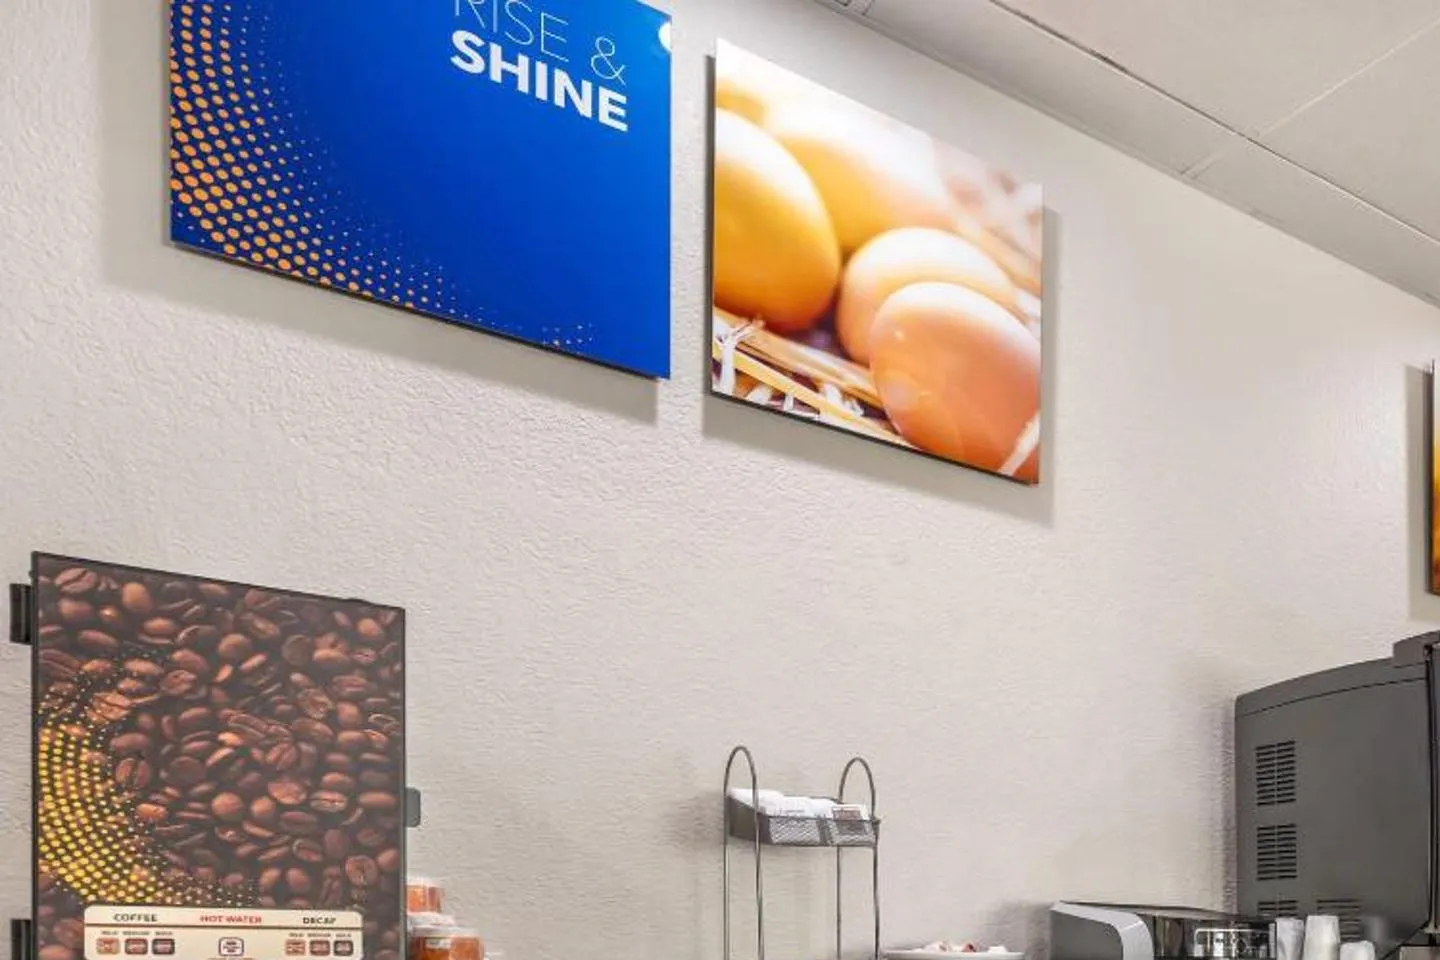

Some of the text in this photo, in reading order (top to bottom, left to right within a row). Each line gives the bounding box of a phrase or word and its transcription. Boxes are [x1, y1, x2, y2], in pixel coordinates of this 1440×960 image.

[591, 36, 626, 86] &
[451, 30, 629, 132] SHINE
[113, 913, 159, 922] COFFEE
[200, 915, 224, 923] HOT
